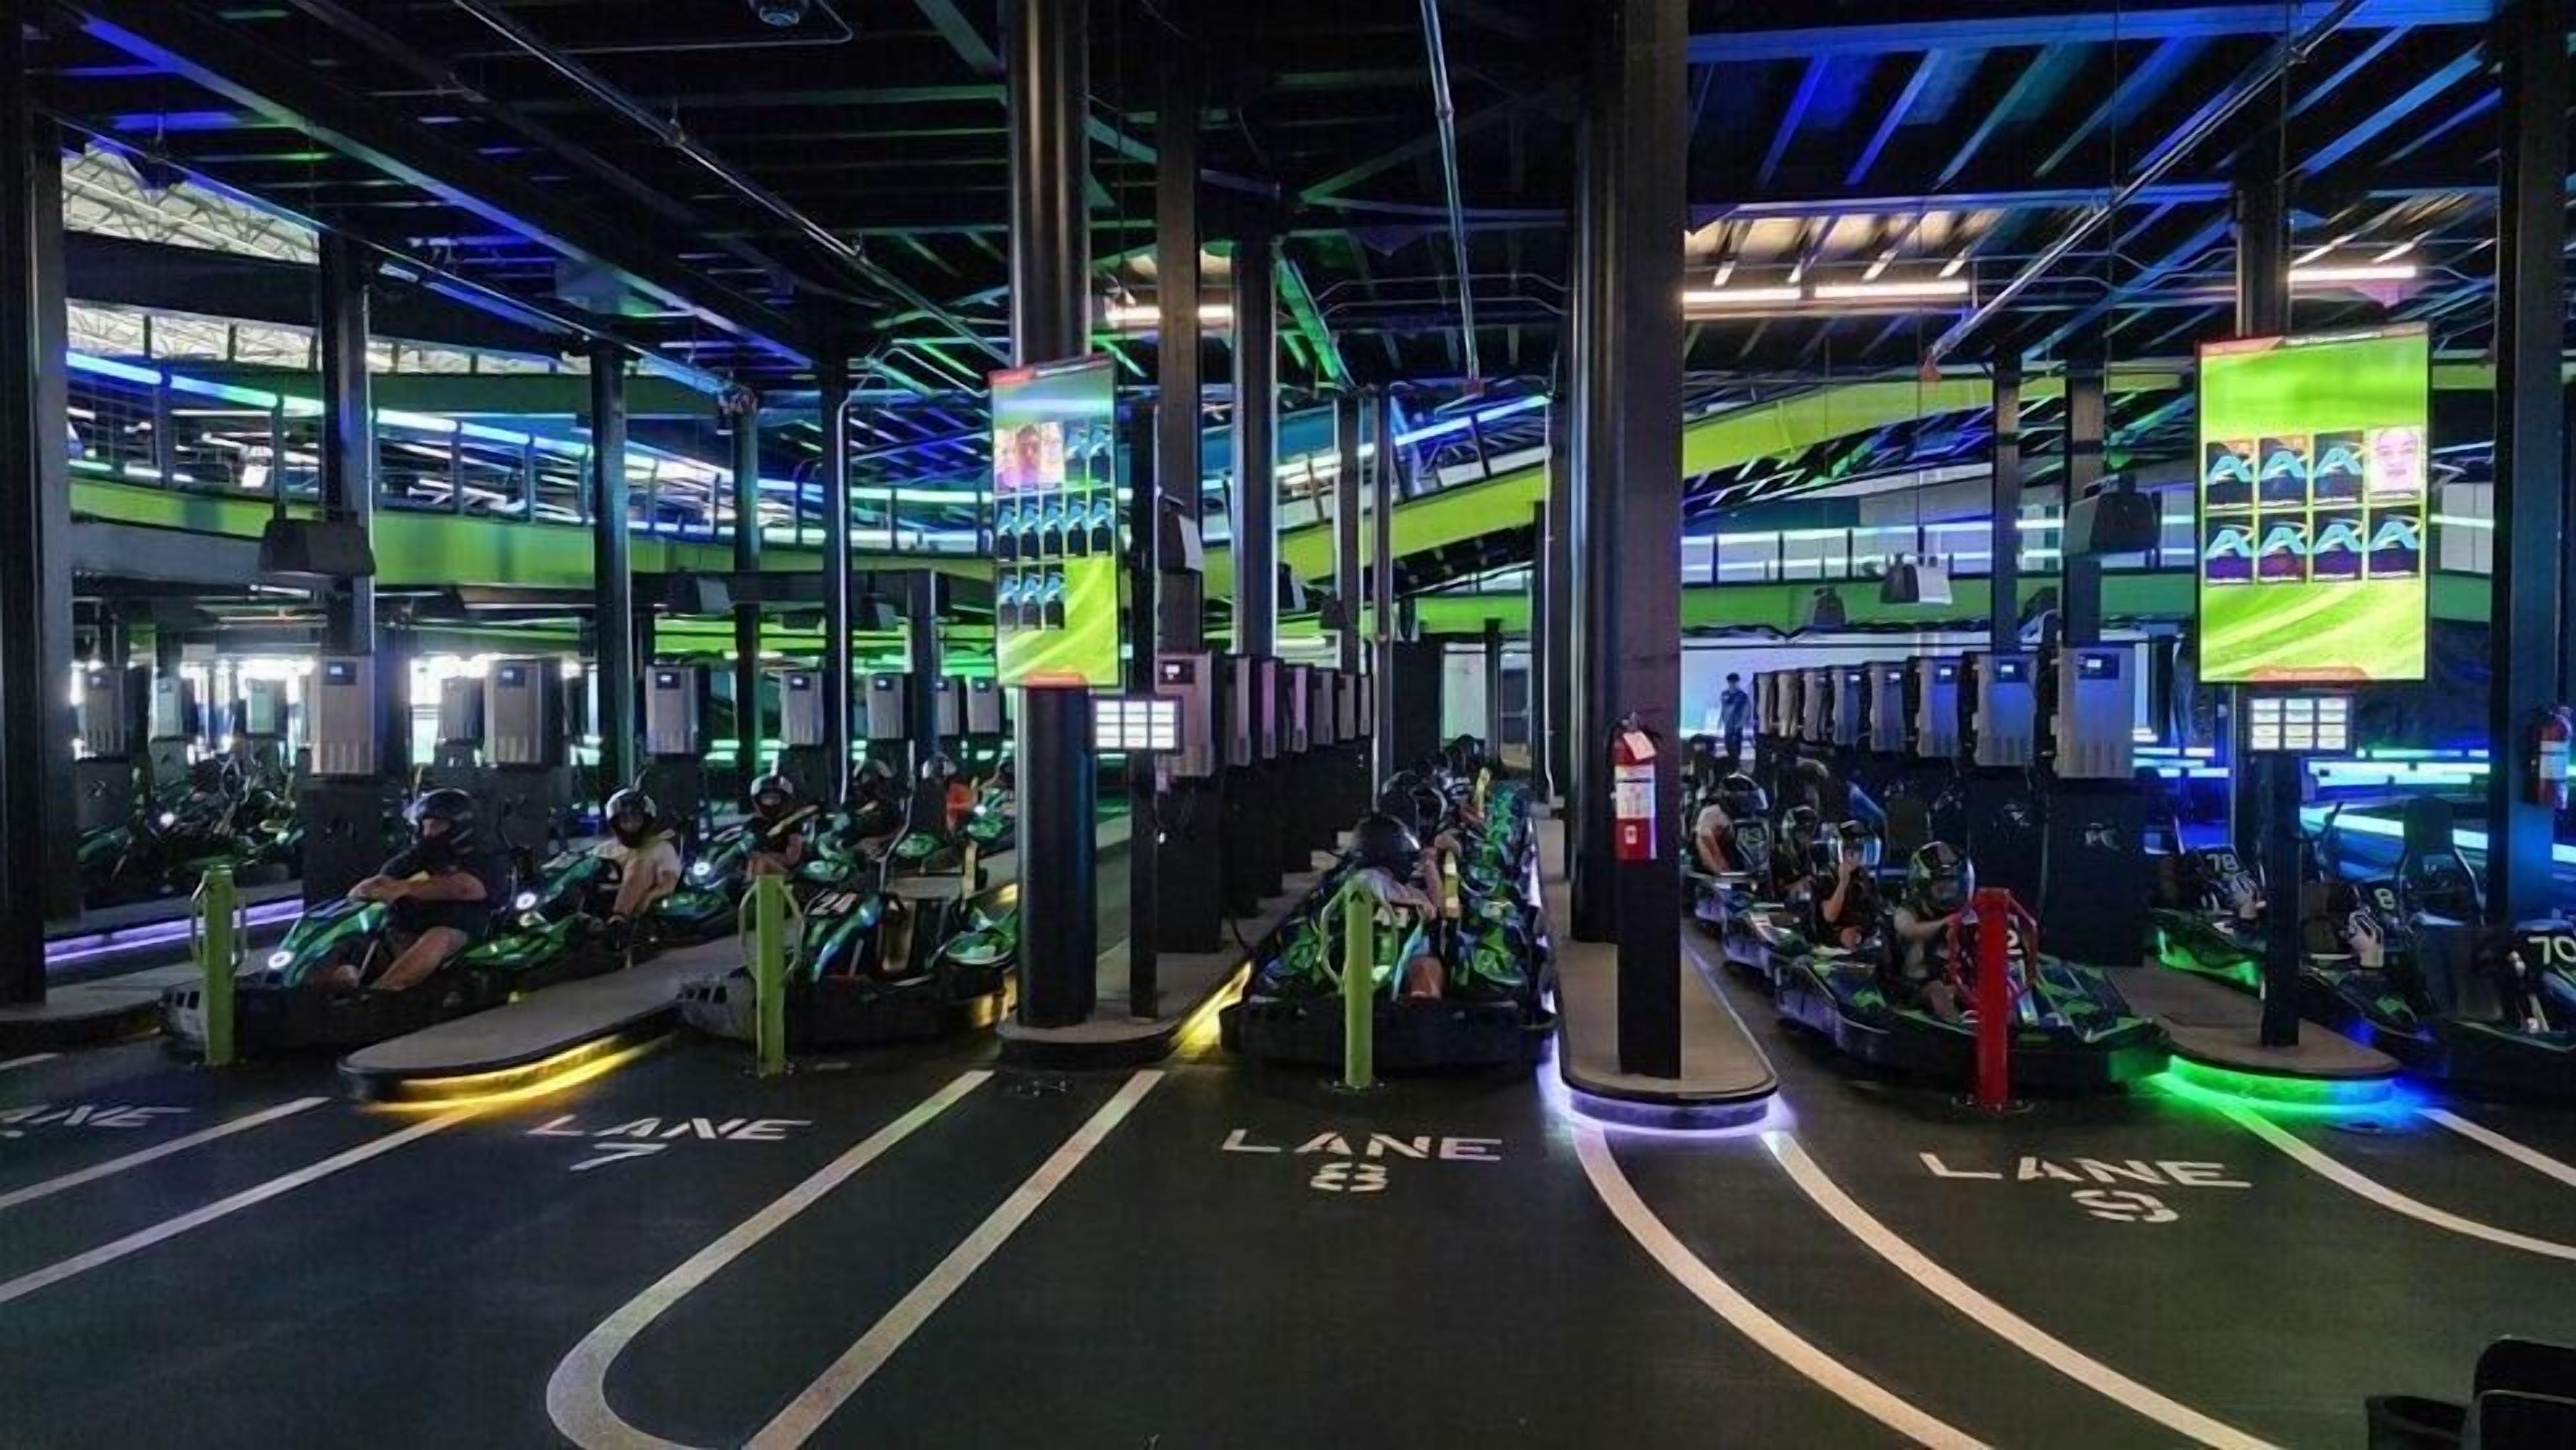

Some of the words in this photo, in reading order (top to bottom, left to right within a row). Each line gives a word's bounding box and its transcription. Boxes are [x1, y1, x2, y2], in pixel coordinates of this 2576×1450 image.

[527, 1115, 812, 1140] LANE
[1221, 1128, 1503, 1161] LANE
[1310, 1161, 1388, 1192] 8
[1919, 1151, 2252, 1187] LANE
[2070, 1190, 2179, 1223] 9
